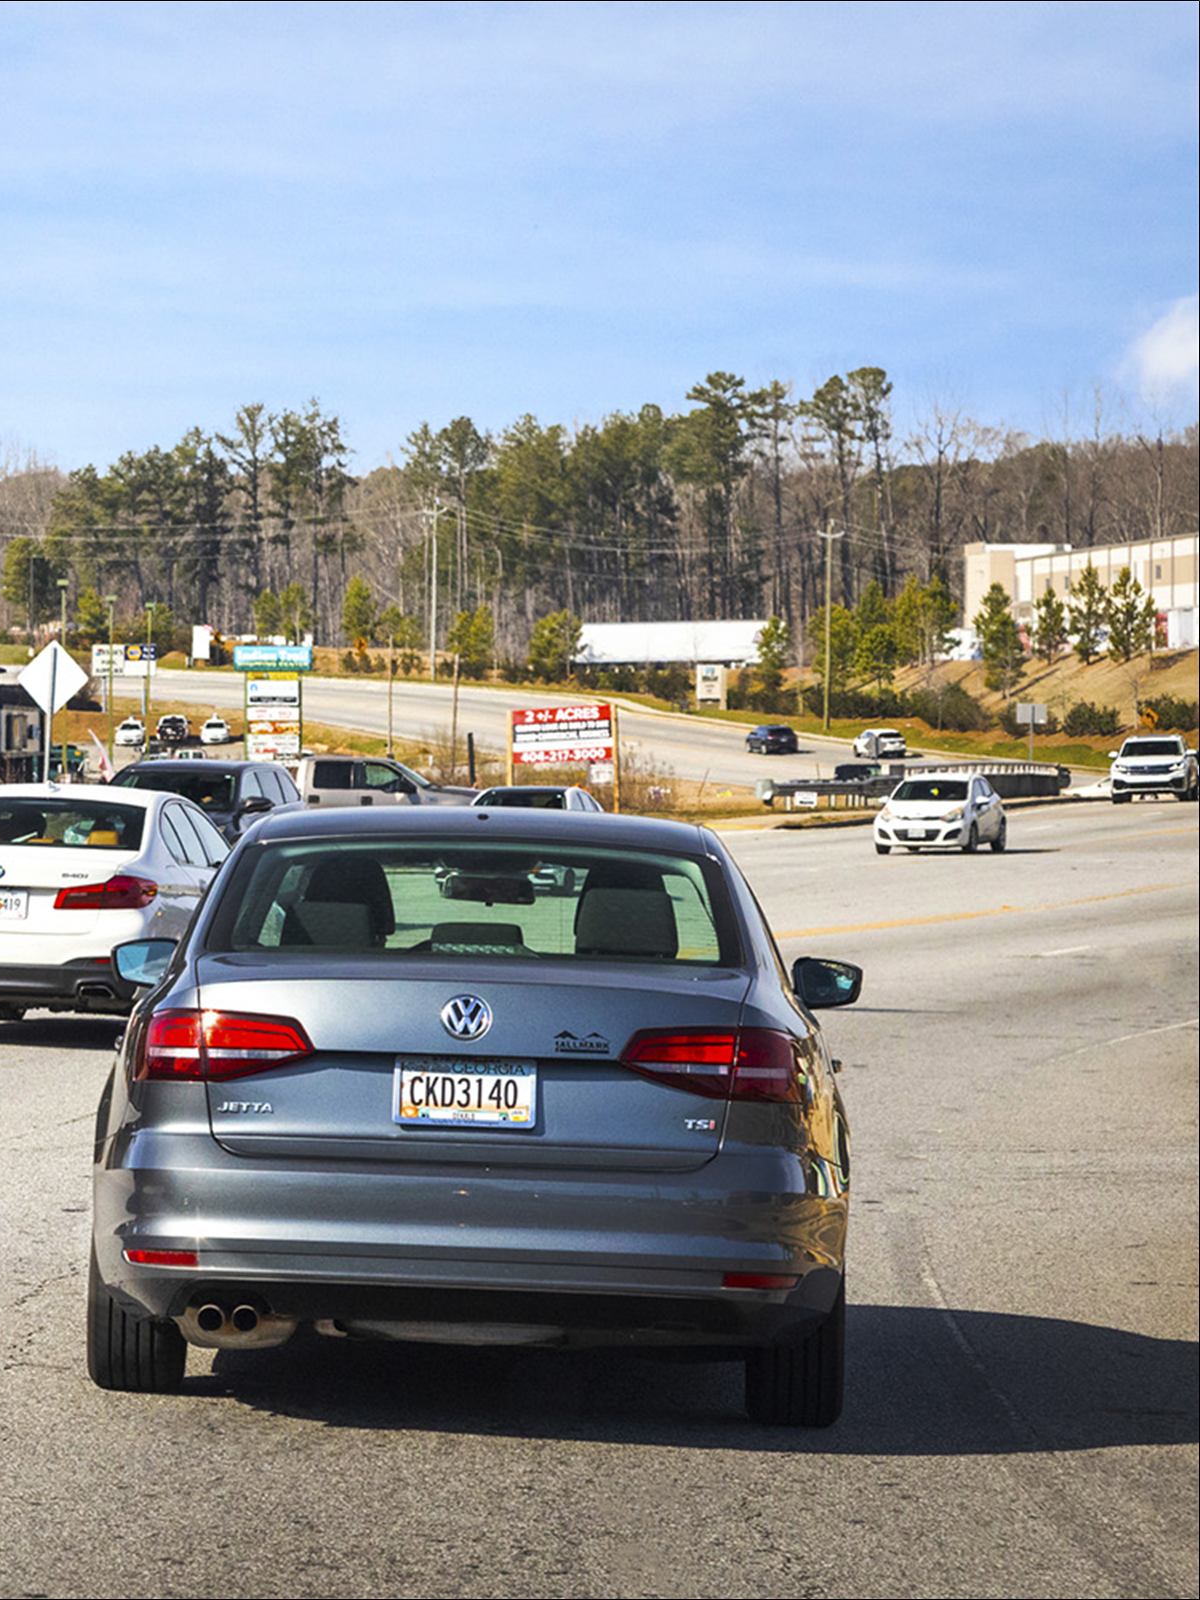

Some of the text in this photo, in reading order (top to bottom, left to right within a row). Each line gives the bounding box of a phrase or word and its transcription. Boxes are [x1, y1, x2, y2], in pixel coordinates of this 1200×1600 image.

[524, 707, 600, 722] 2 +/- ACRES
[521, 748, 606, 763] 404-217-3000
[451, 1063, 526, 1076] GEORGIA
[410, 1076, 518, 1109] CKD3140
[217, 1101, 273, 1114] JETTA
